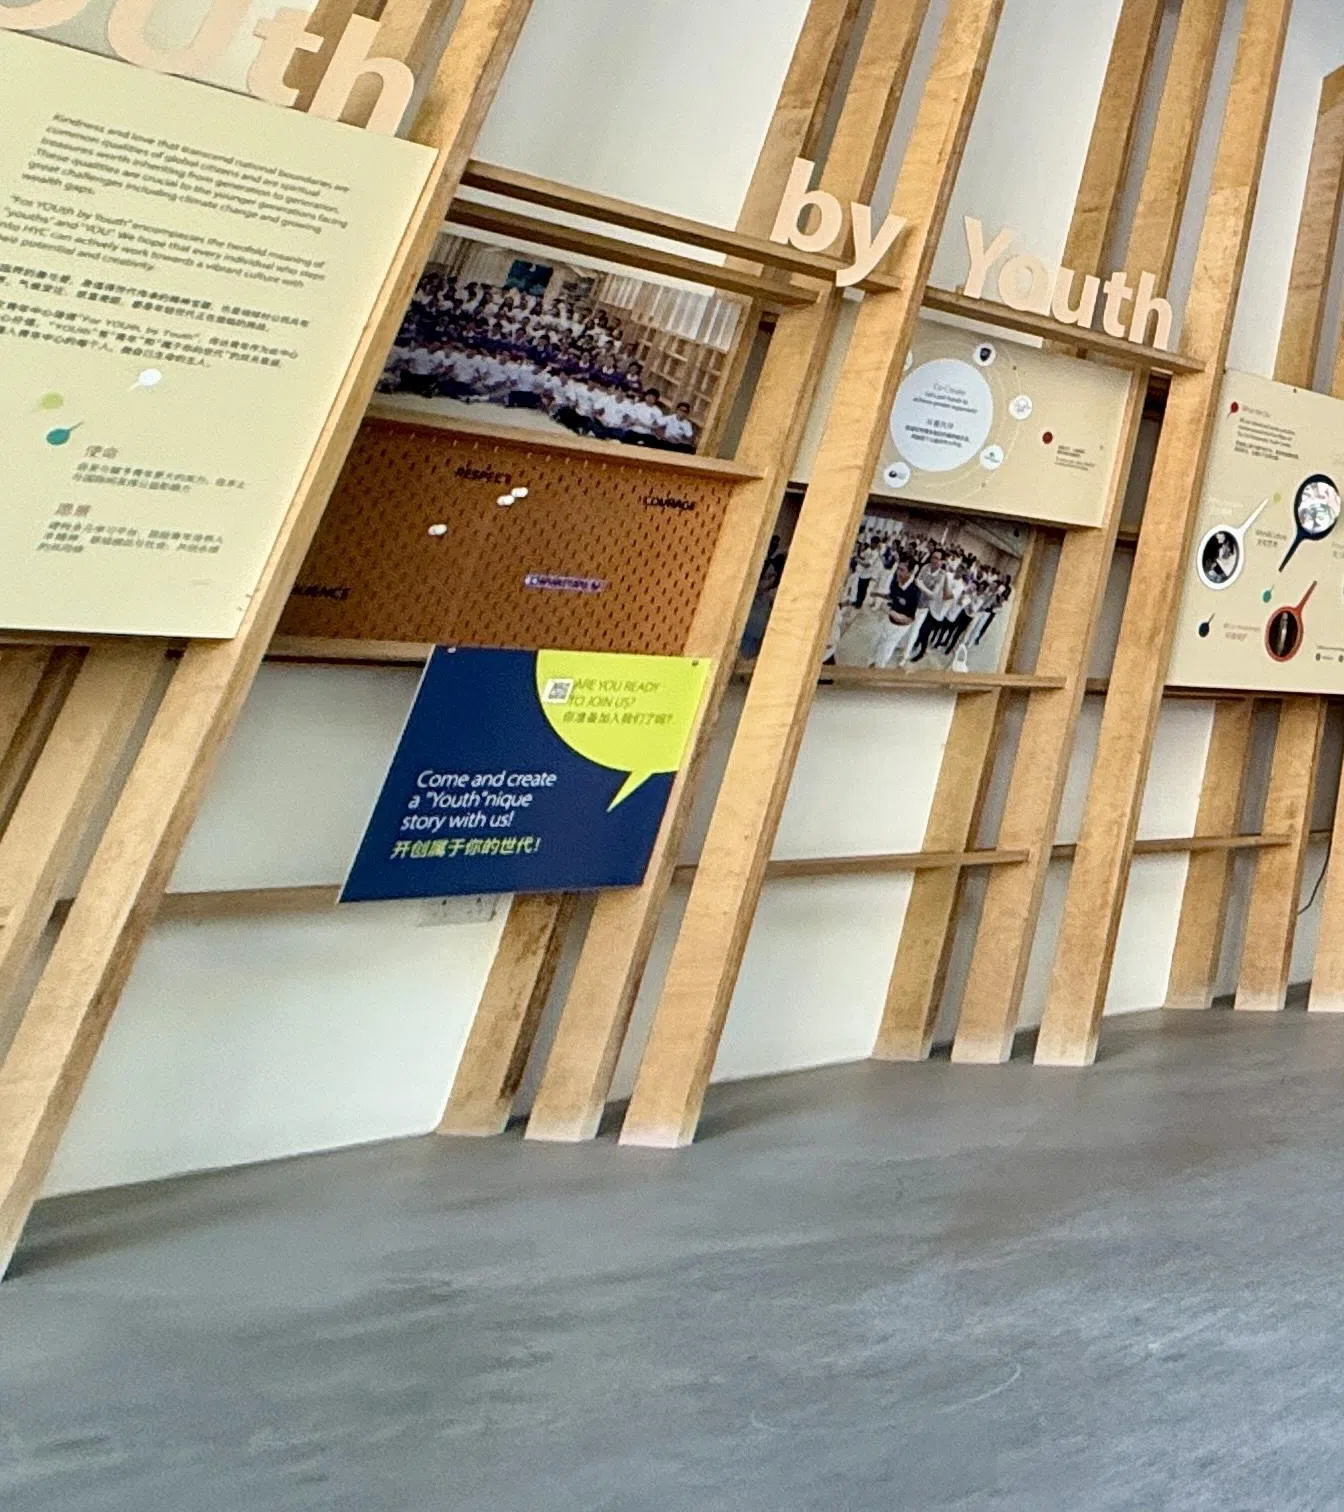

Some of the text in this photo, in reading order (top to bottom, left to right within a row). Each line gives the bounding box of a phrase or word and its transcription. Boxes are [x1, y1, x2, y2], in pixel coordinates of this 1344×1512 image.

[770, 157, 1173, 350] by Youth
[573, 678, 660, 693] ARE YOU READY
[586, 695, 613, 707] JOIN
[613, 696, 636, 710] US?
[416, 770, 558, 788] Come and create
[407, 794, 421, 810] a
[400, 810, 516, 834] story with us!
[389, 835, 542, 860] 开创属于你的世代!
